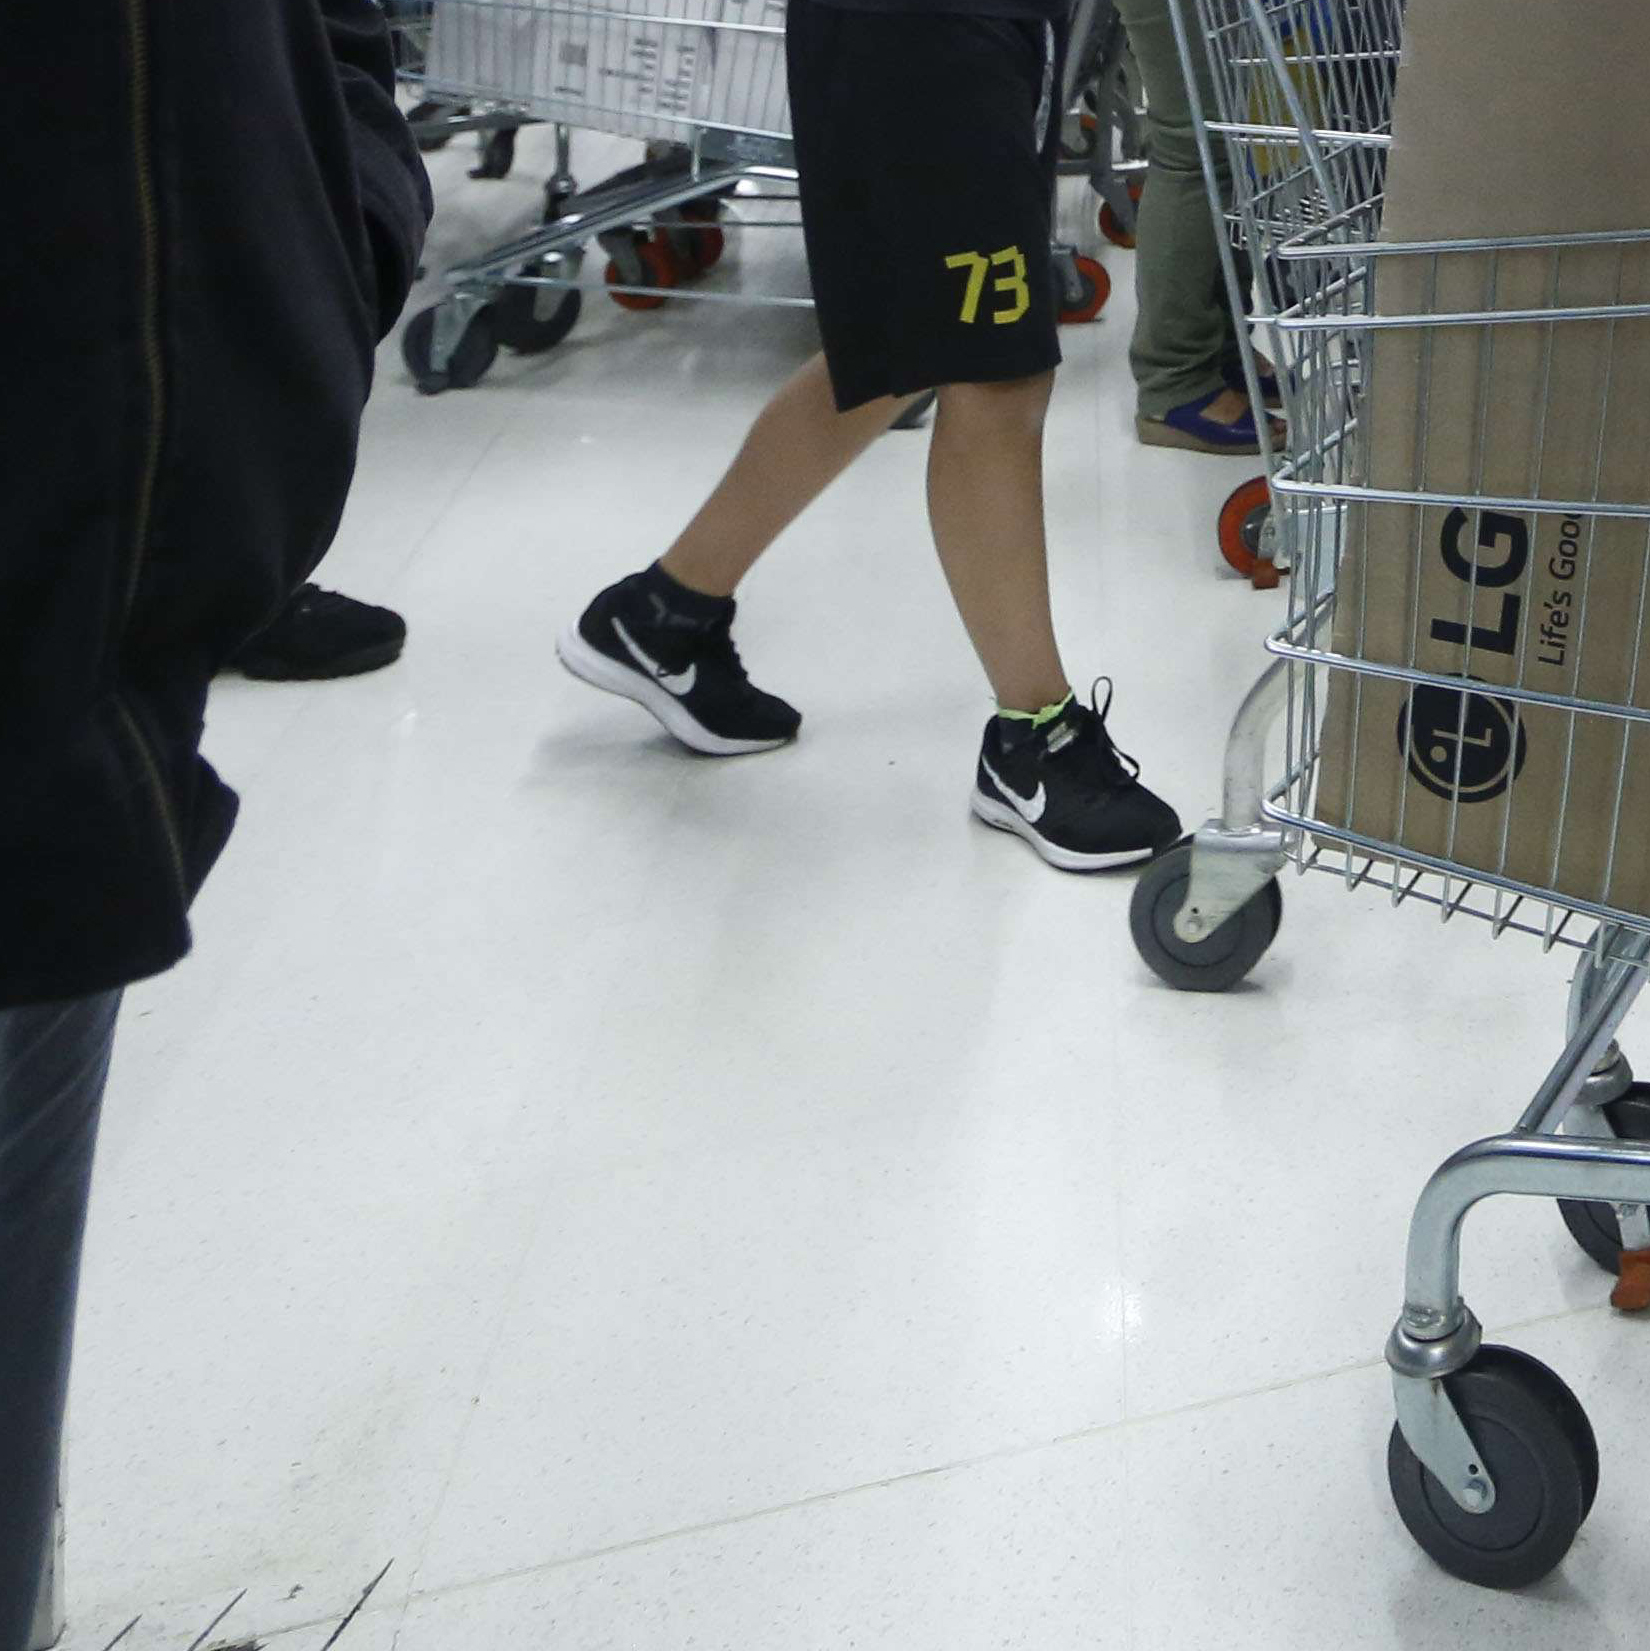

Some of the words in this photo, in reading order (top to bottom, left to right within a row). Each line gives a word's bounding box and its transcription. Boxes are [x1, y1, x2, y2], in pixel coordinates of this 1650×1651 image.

[944, 245, 1031, 324] 73
[1430, 506, 1529, 656] LG
[1537, 590, 1572, 667] Life's
